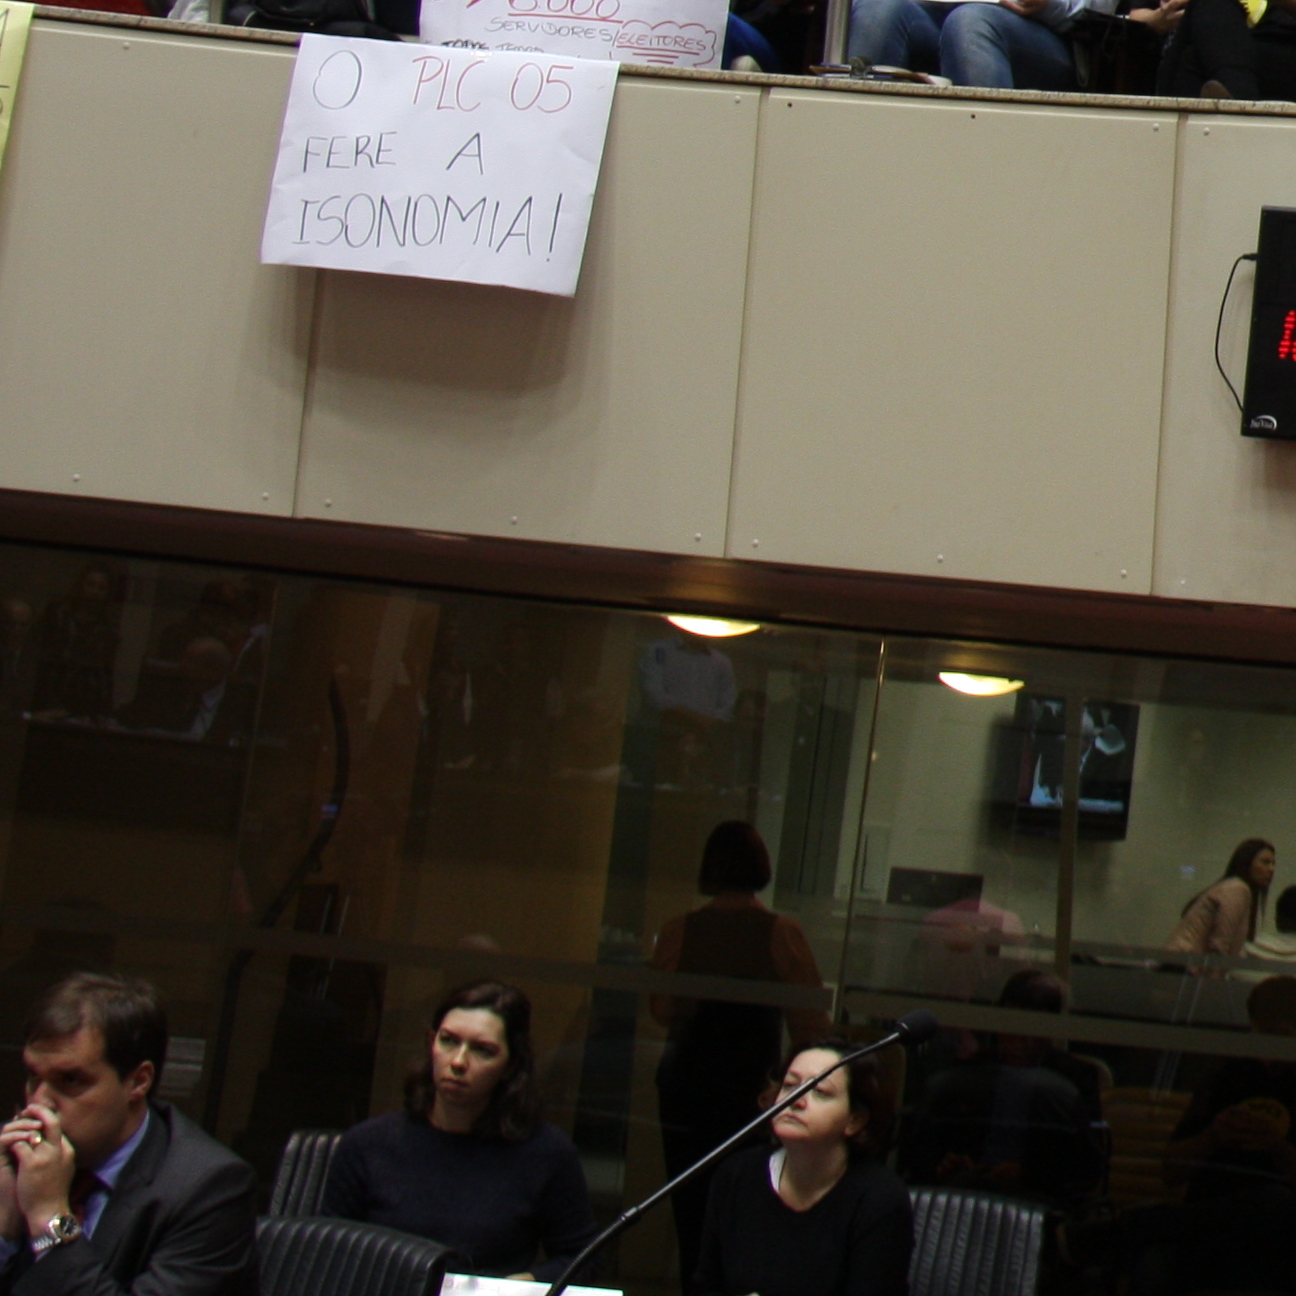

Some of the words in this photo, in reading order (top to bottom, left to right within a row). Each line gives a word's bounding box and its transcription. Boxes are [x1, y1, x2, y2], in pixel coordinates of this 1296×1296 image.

[312, 50, 362, 109] O
[412, 55, 486, 112] PLC
[511, 62, 574, 113] 05
[303, 131, 397, 173] FERE
[445, 132, 484, 175] A
[291, 193, 563, 263] ISONOMIA!
